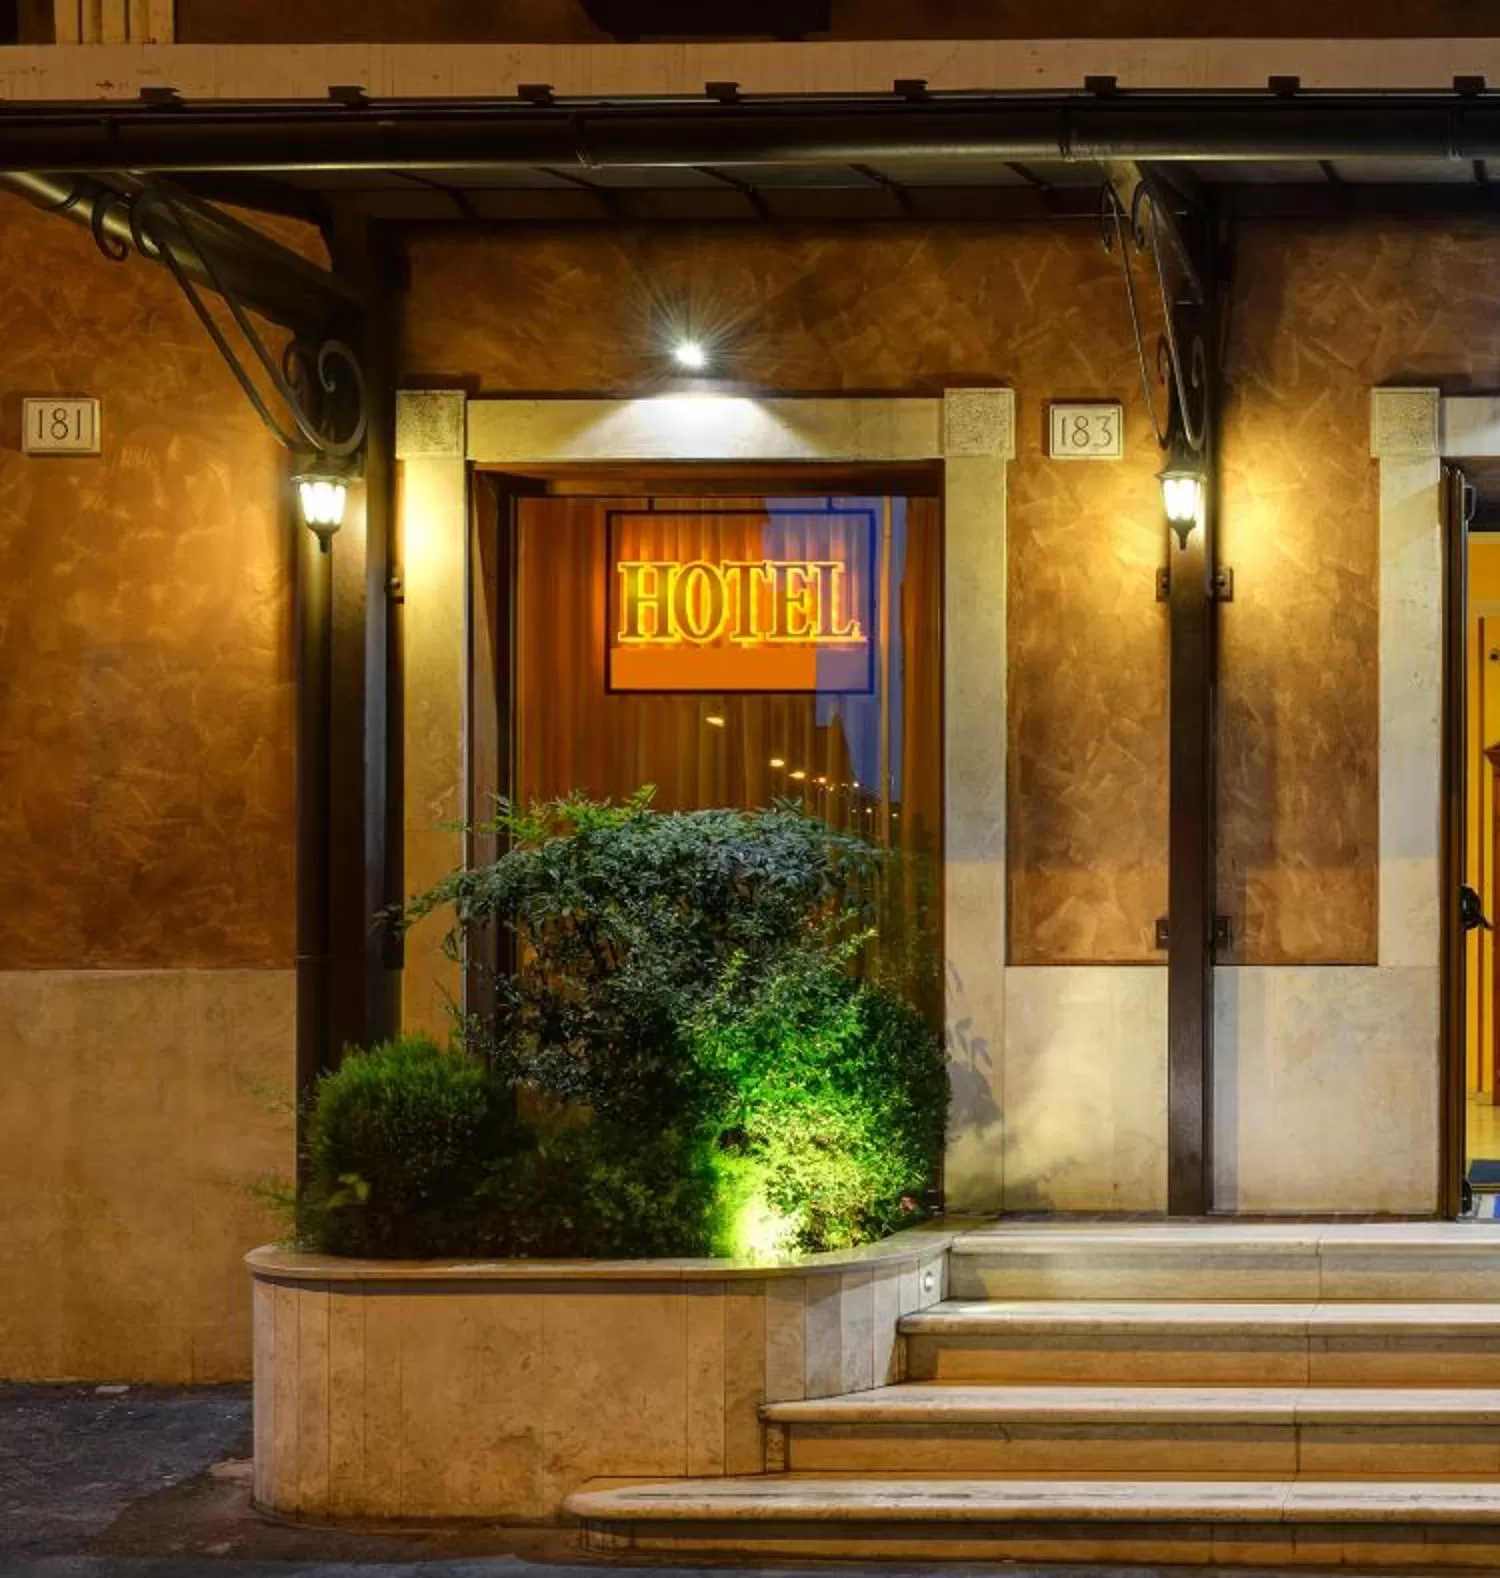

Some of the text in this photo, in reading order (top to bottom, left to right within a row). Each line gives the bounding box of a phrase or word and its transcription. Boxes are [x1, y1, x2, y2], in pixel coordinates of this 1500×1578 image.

[38, 407, 81, 440] 181
[1061, 415, 1113, 448] 183
[617, 560, 868, 645] HOTEL
